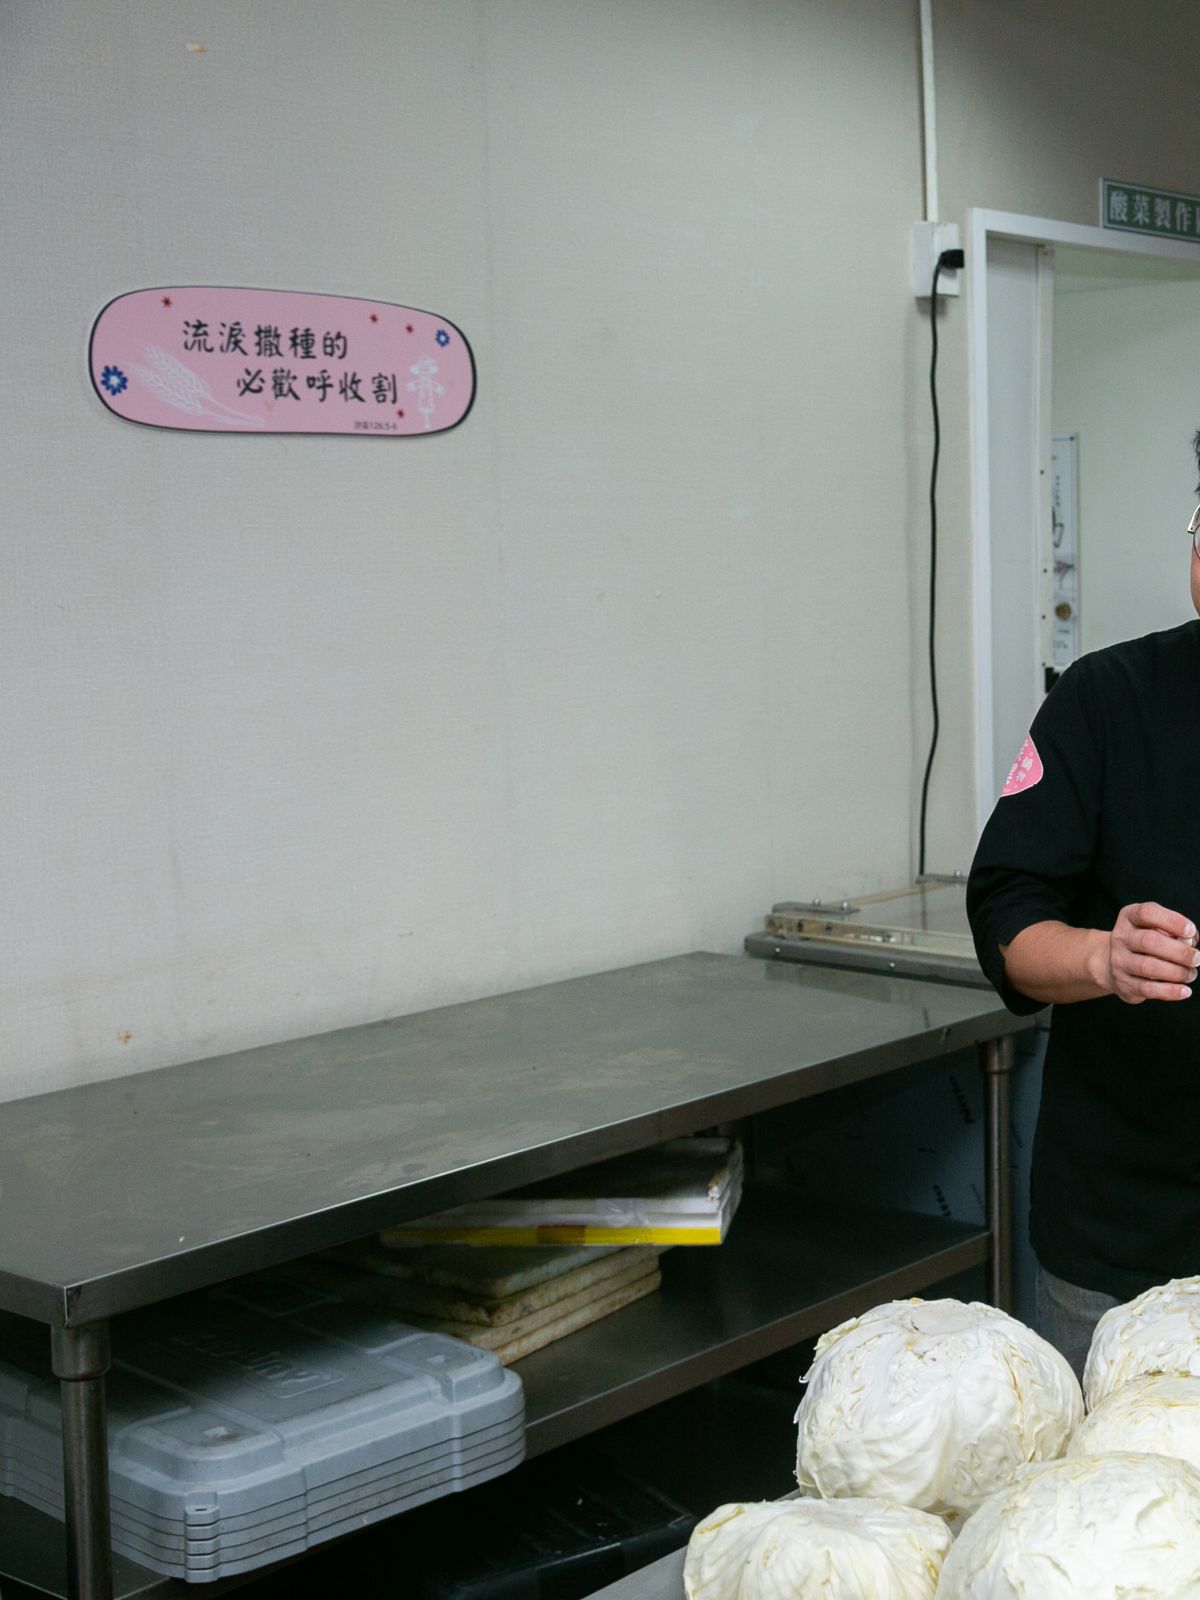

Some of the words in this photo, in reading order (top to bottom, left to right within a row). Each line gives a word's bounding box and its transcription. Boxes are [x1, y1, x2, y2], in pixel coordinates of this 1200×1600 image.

[182, 319, 348, 360] 流淚撒種的
[236, 368, 398, 405] 必歡呼收割
